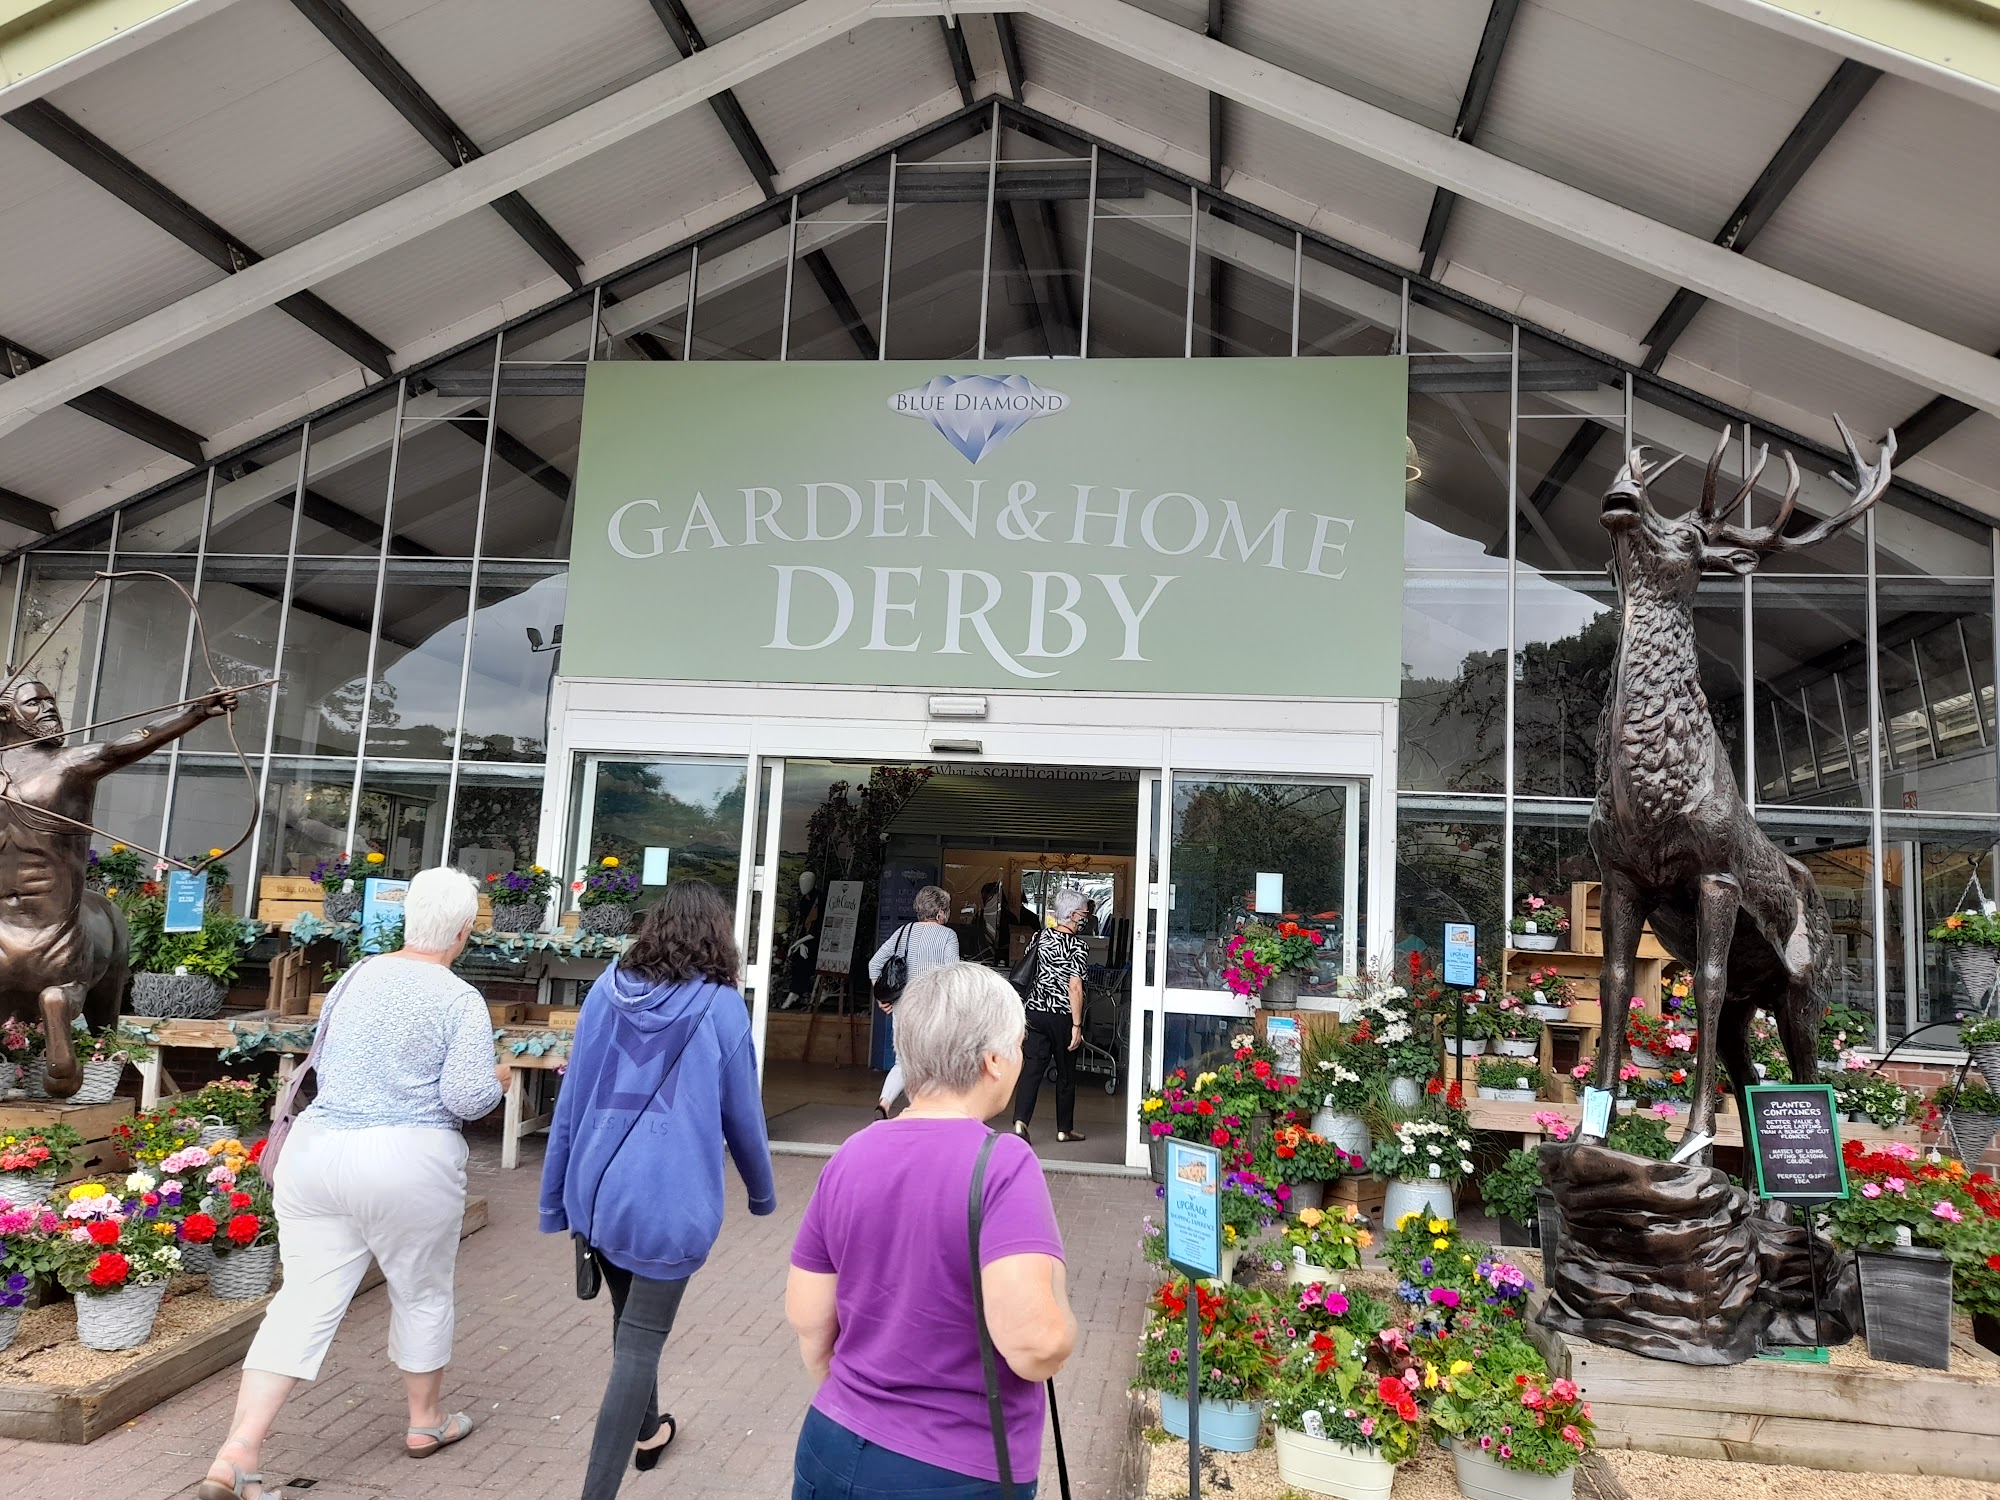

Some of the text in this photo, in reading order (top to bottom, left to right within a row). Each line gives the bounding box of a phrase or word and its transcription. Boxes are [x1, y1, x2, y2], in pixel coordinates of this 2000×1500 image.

[896, 393, 1063, 412] BLUE DIAMOND
[607, 477, 1355, 581] GARDEN & HOME
[760, 564, 1182, 679] DERBY
[933, 763, 966, 777] What
[983, 765, 1098, 781] scarification?
[1763, 1108, 1822, 1117] CONTAINERS
[1770, 1101, 1812, 1109] PLANTED
[1176, 1200, 1208, 1218] UPGRADE
